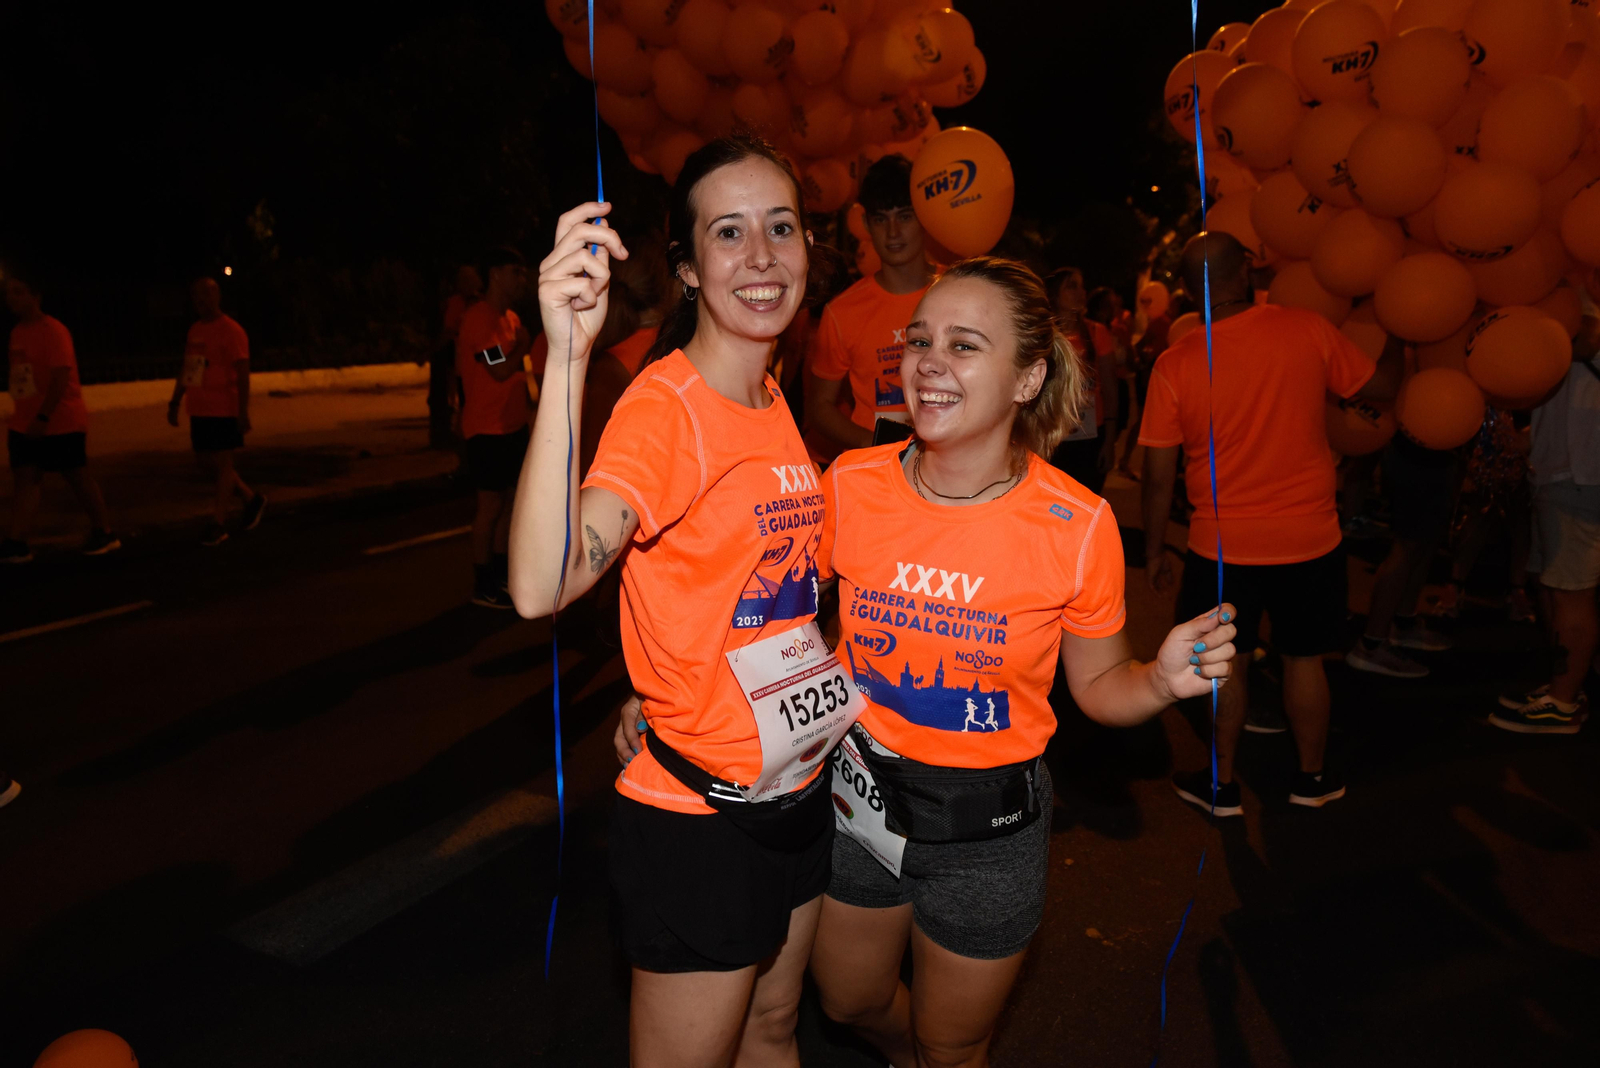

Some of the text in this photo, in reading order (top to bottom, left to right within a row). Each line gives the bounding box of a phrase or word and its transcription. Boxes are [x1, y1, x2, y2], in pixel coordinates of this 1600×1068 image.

[876, 344, 905, 354] CARRER
[754, 498, 801, 517] CARRERA
[757, 517, 768, 537] DEL
[888, 562, 985, 604] XXXV
[854, 587, 1008, 627] CARRERA NOCTURNA
[736, 615, 764, 627] 2023
[850, 599, 1007, 645] DEL GUADALQUIVIR
[780, 674, 805, 688] NOCTURNA
[779, 674, 849, 732] 15253
[791, 714, 847, 747] CRISTINA GARCÍA LÓPEZ
[991, 810, 1023, 828] SPORT
